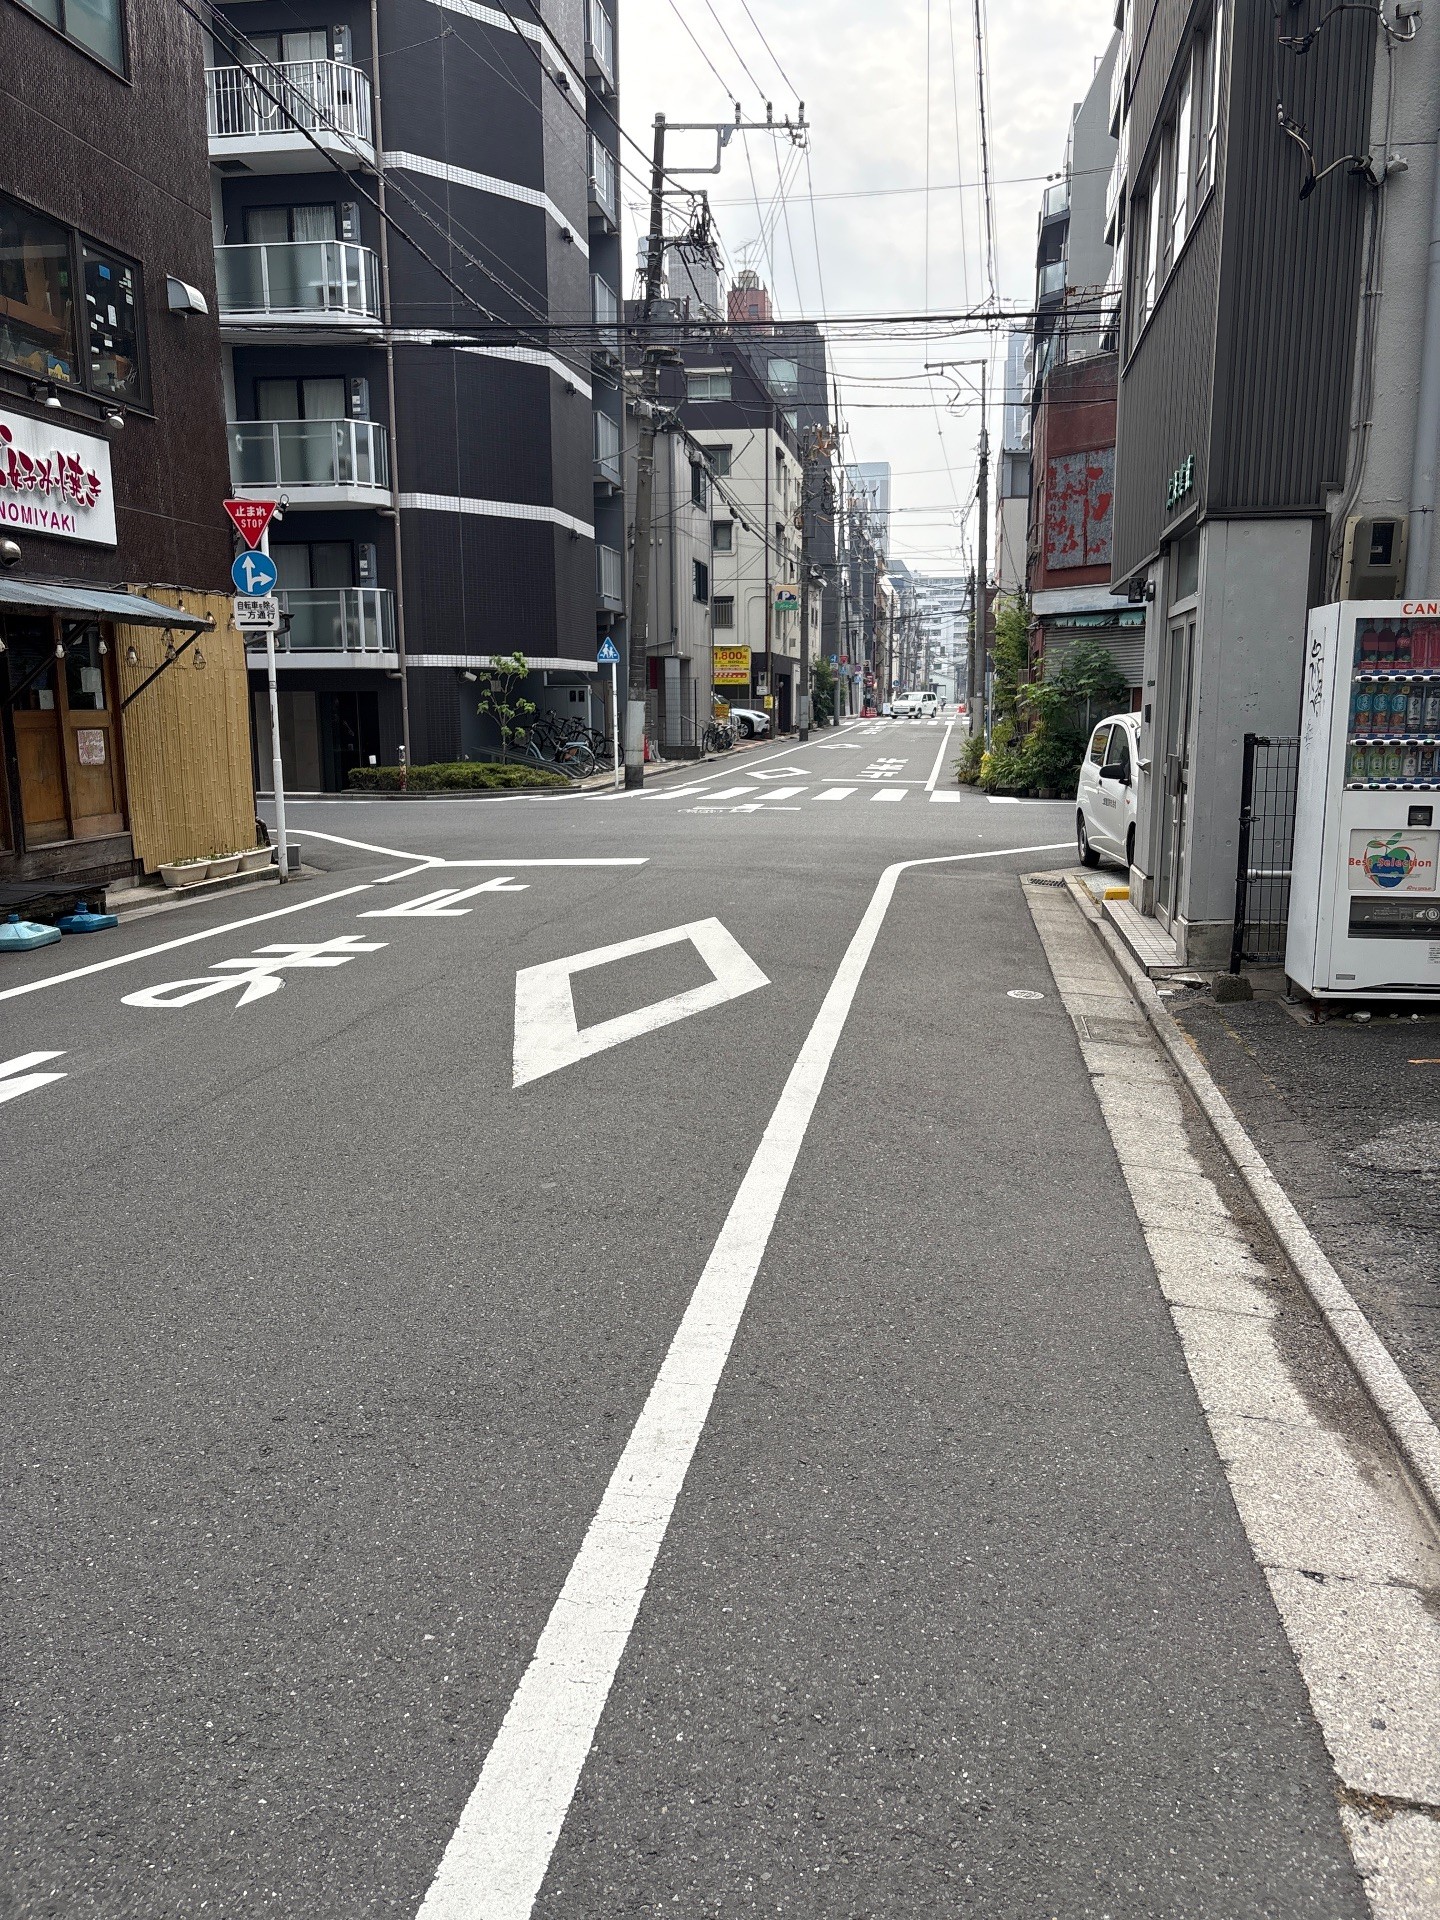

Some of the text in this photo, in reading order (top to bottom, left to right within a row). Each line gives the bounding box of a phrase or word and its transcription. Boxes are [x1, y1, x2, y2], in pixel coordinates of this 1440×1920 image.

[0, 424, 102, 508] 好み焼き
[235, 505, 267, 517] 止まれ
[241, 518, 263, 528] STOP
[237, 601, 275, 610] 自転車を除く
[238, 611, 275, 620] 一方通行
[1348, 857, 1432, 868] Best Selection
[0, 877, 530, 1105] 止ま
